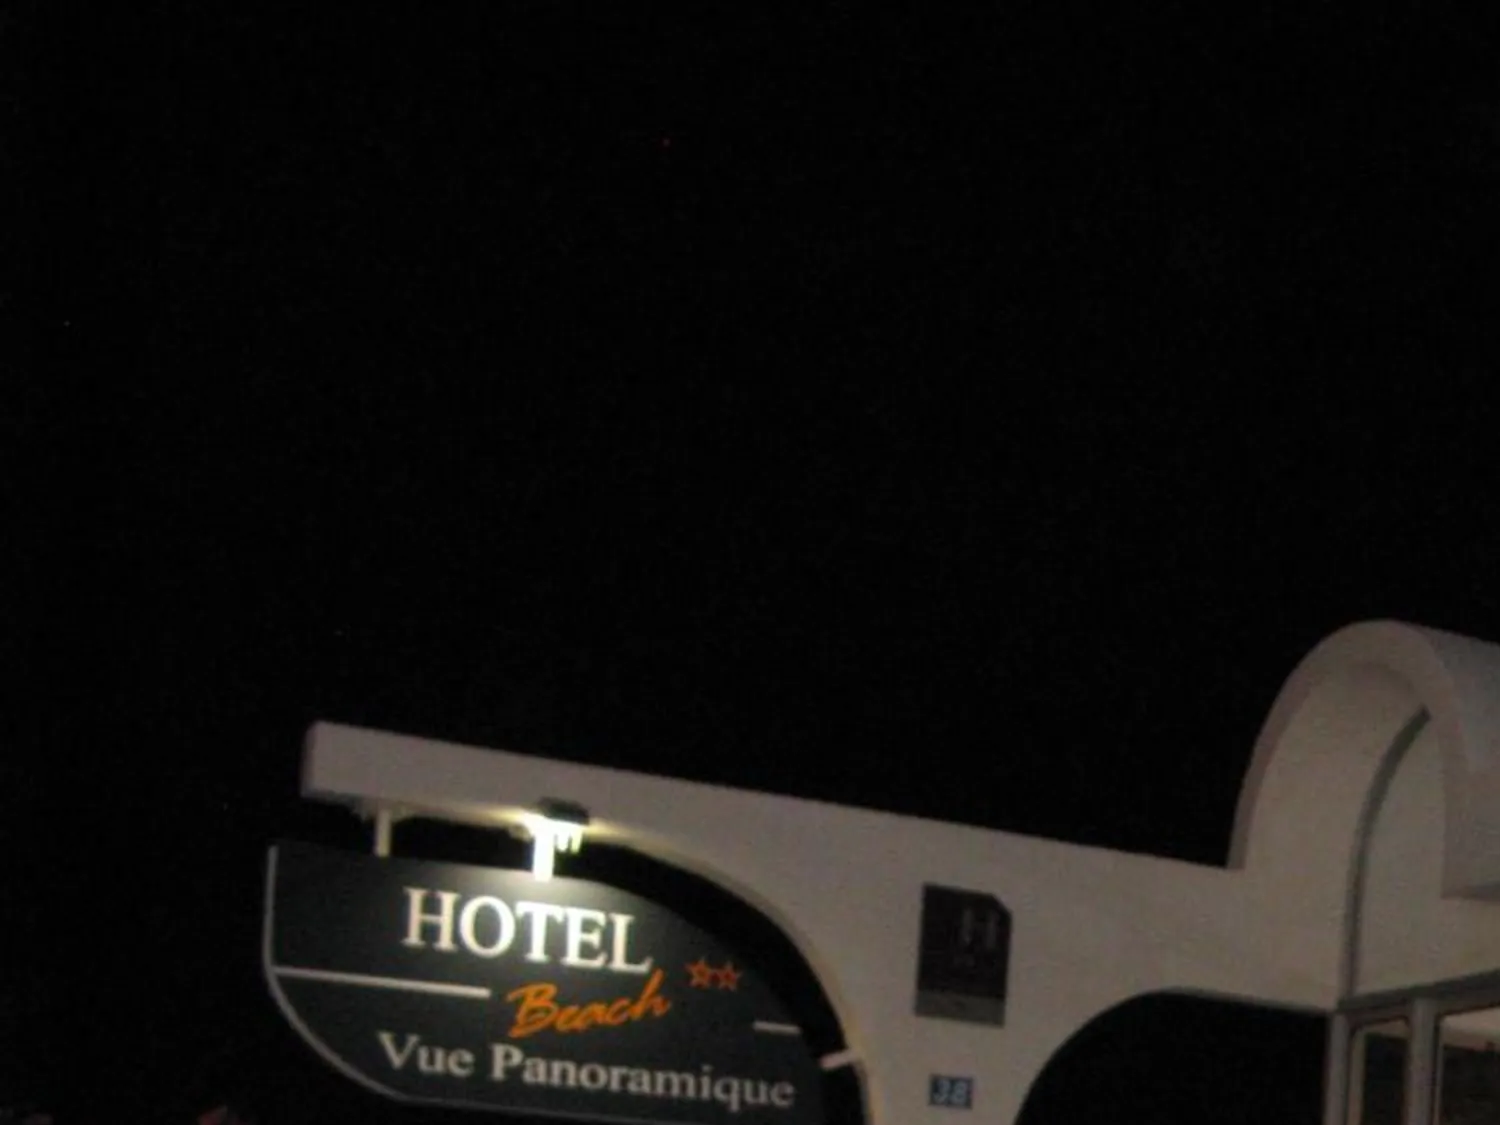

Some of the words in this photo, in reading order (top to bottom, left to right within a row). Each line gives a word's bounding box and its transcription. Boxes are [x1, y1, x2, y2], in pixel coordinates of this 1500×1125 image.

[402, 887, 653, 973] HOTEL
[507, 968, 671, 1038] Beach
[378, 1031, 475, 1078] Vue
[490, 1042, 796, 1111] Panoramique
